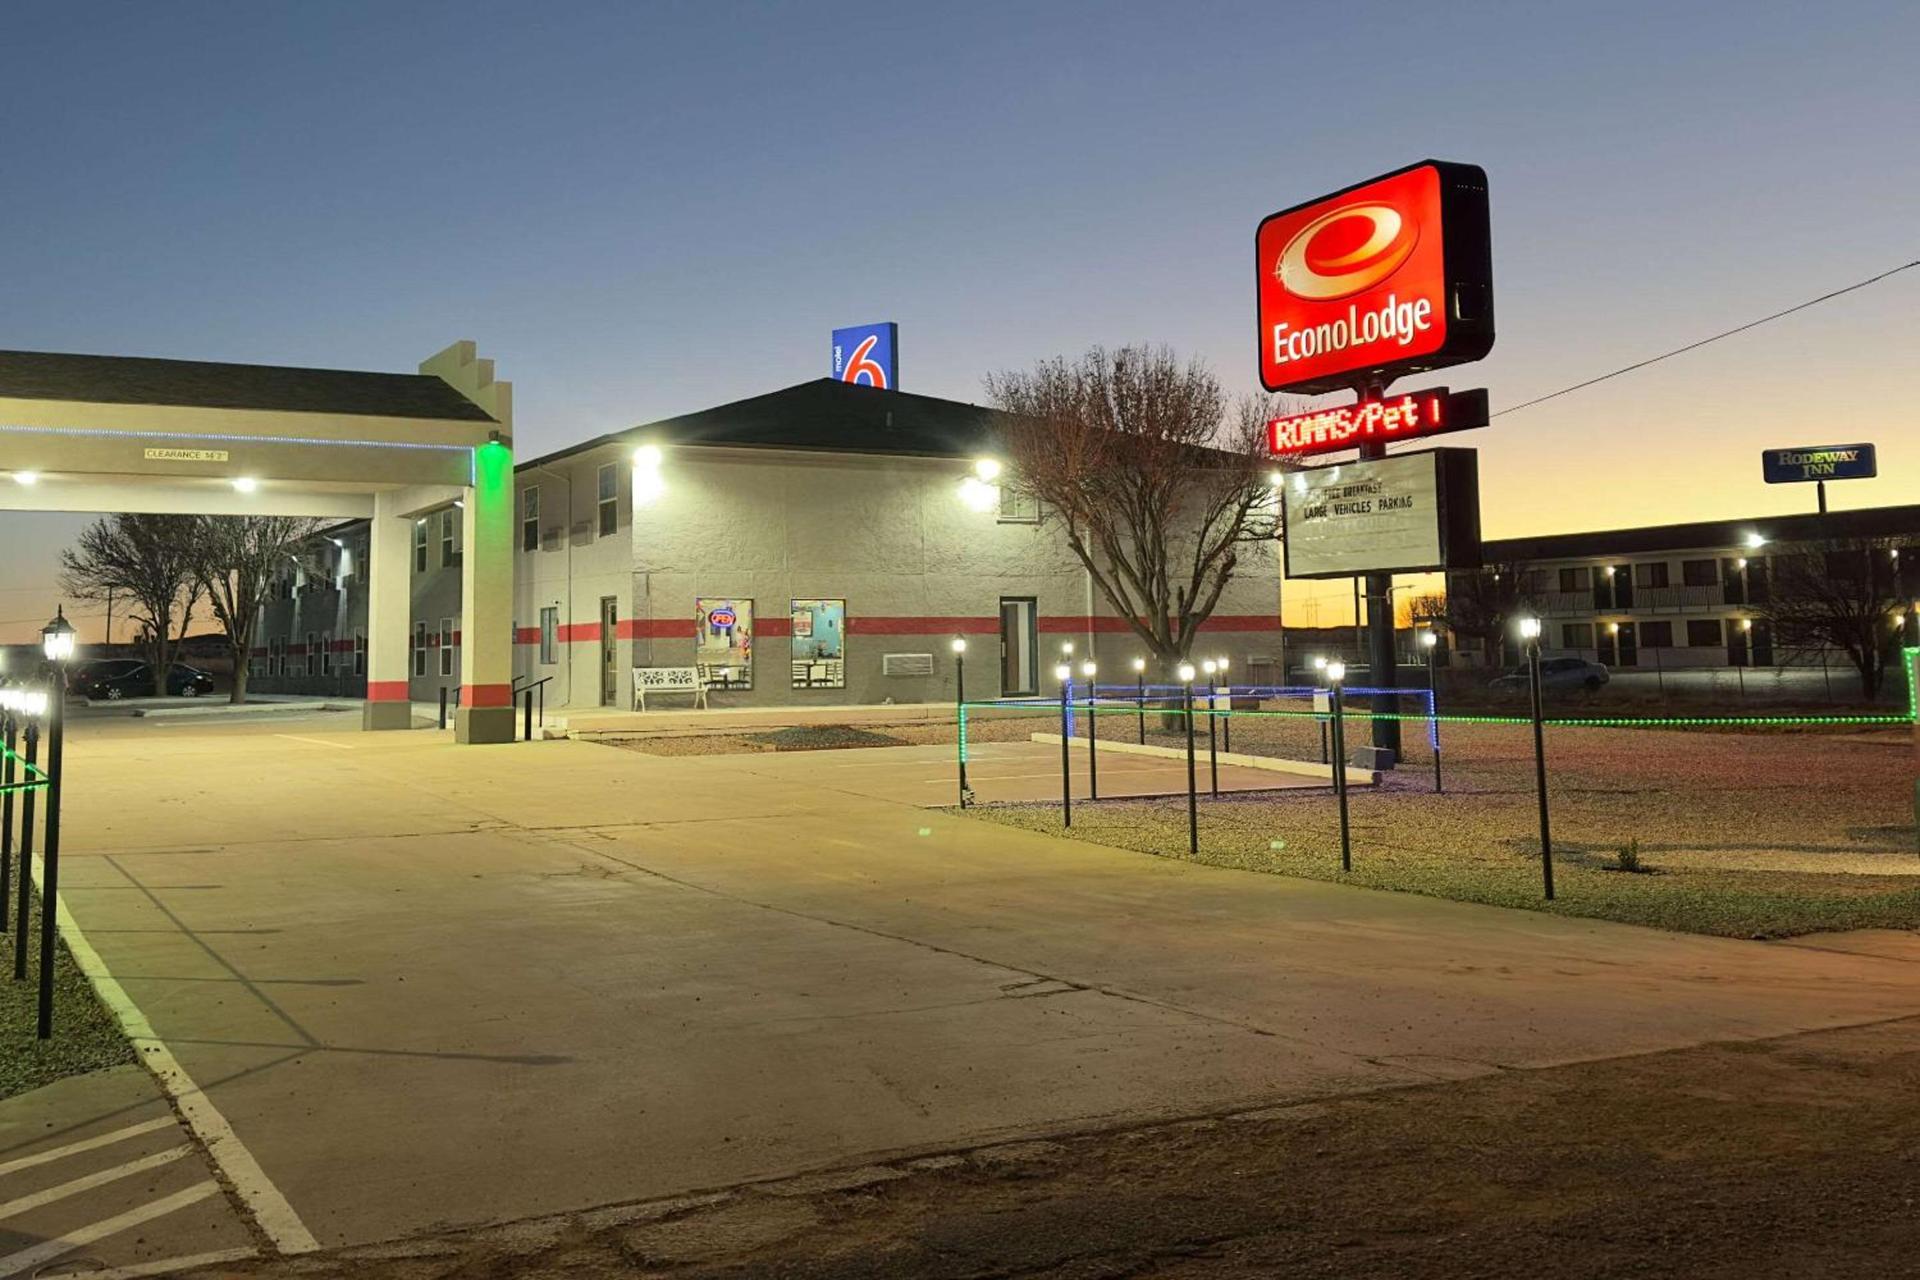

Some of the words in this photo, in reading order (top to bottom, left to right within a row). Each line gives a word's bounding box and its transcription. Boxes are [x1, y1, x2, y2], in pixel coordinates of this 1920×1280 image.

[842, 335, 887, 389] 6
[147, 450, 201, 459] CLEARANCE
[1304, 505, 1328, 519] LARGE
[1334, 501, 1372, 515] VEHICLES
[1379, 496, 1413, 511] PARKING
